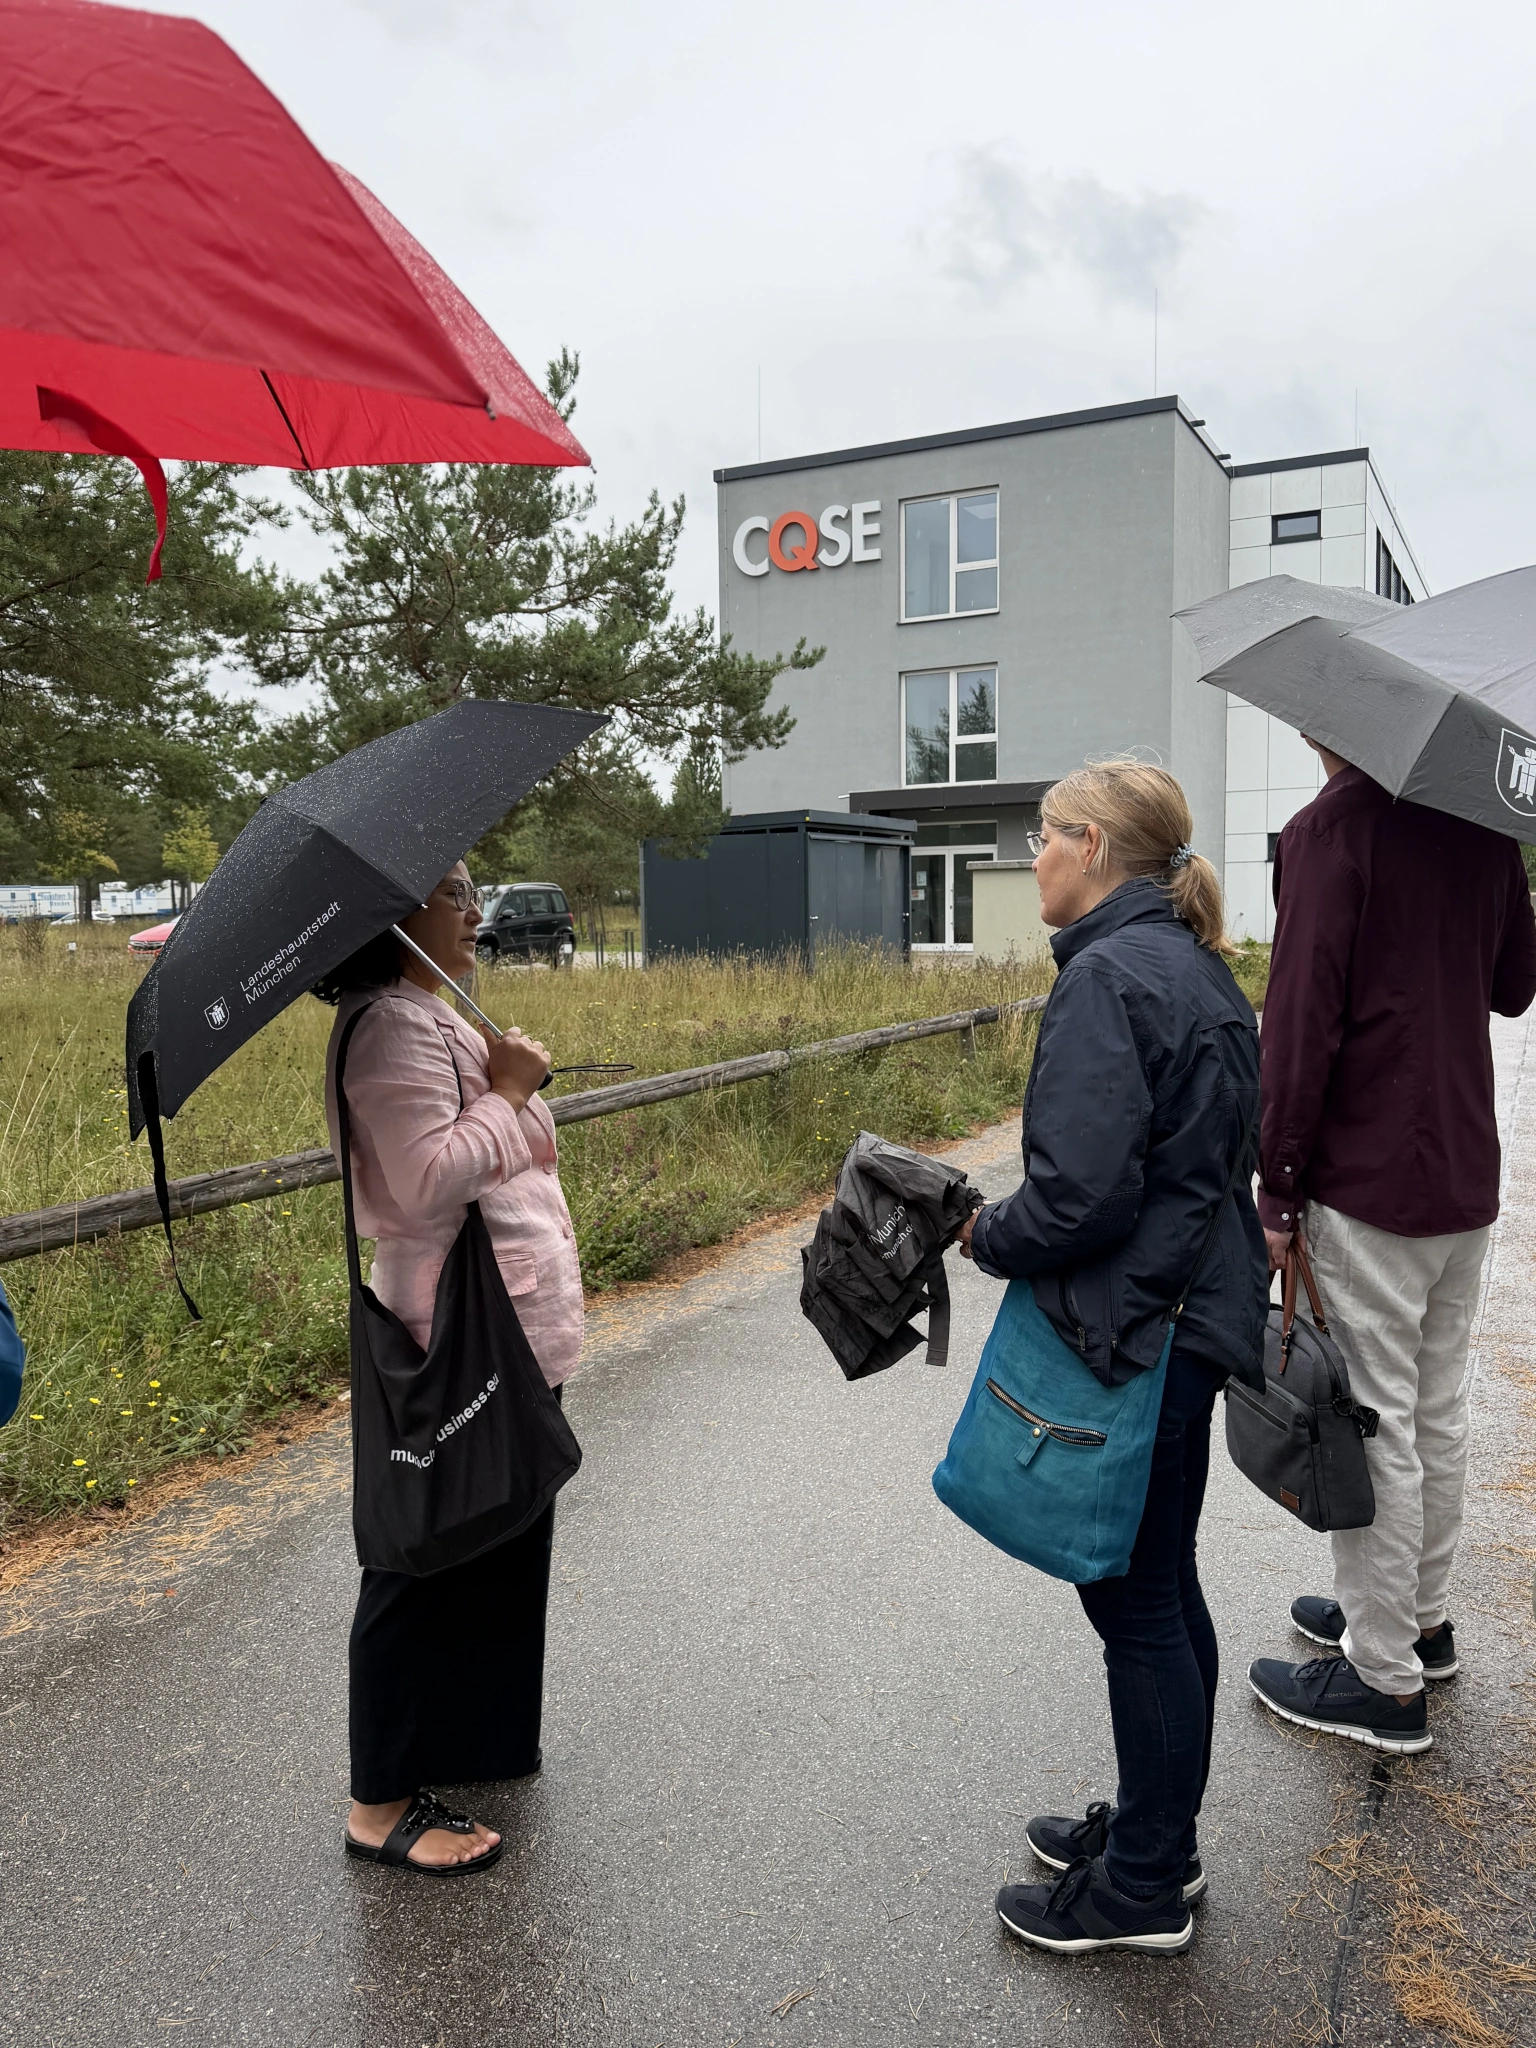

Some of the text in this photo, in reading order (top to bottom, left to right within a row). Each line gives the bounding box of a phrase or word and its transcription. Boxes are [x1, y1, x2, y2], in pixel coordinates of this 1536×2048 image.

[733, 500, 882, 576] CQSE
[240, 901, 341, 992] Landeshauptstadt
[245, 956, 301, 1005] München
